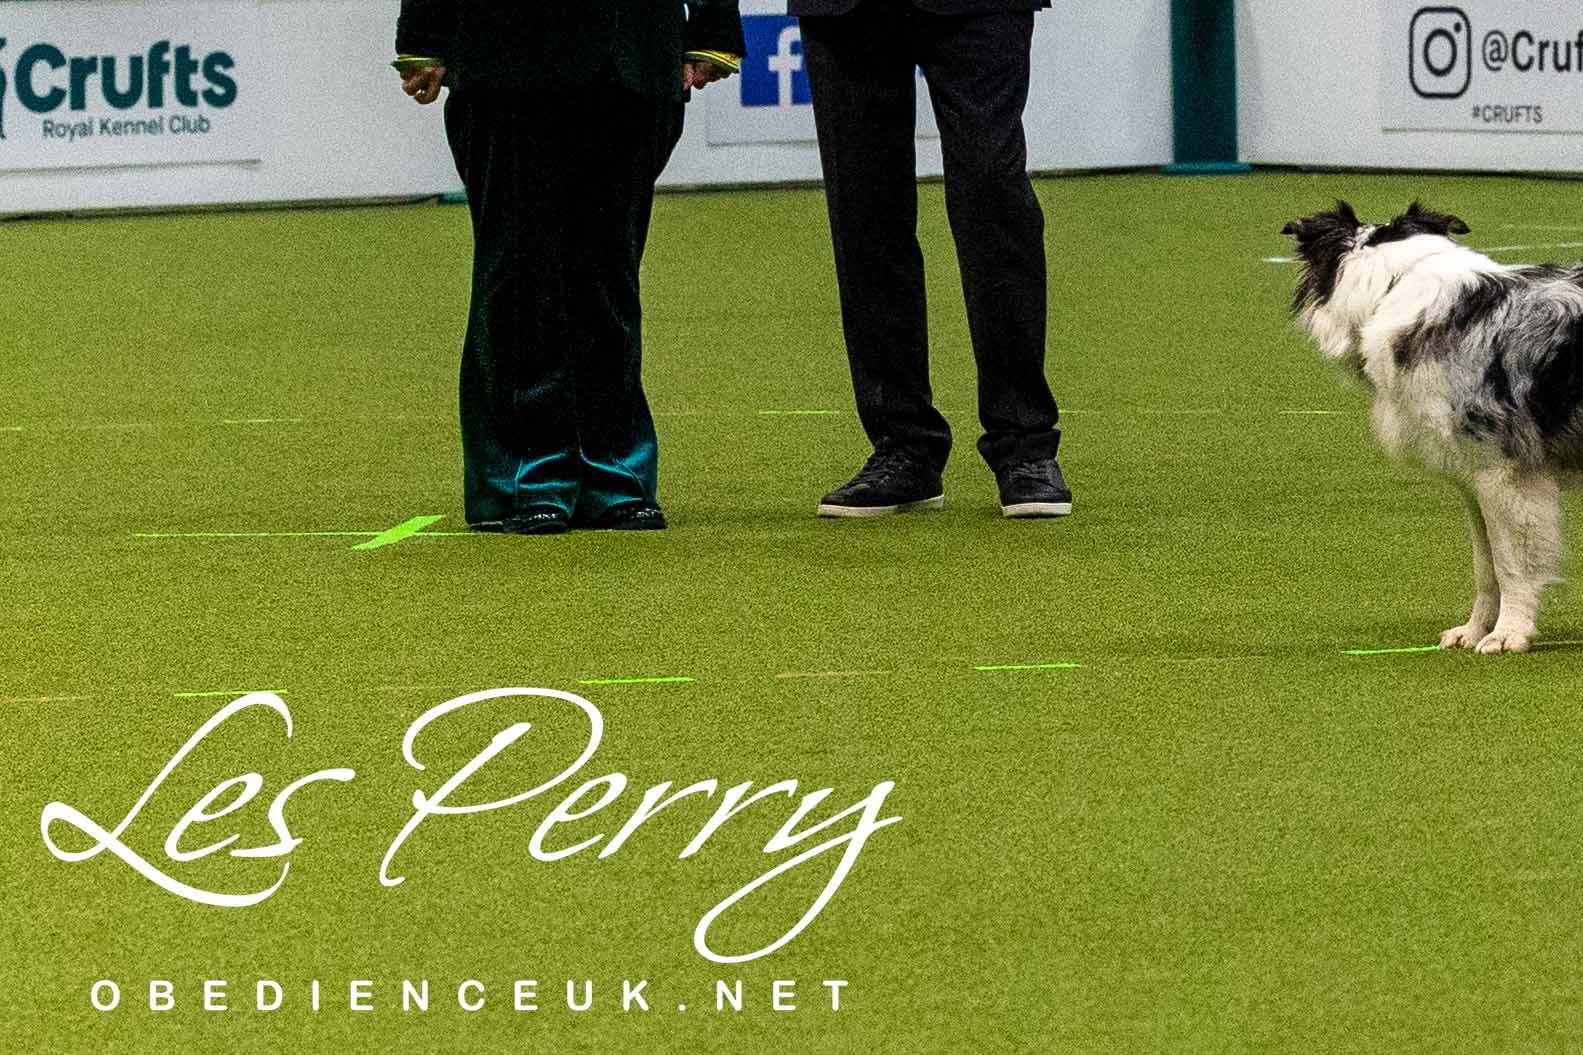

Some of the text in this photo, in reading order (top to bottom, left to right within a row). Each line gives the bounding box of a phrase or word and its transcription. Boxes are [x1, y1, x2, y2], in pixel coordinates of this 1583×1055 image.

[14, 39, 239, 114] Crufts
[42, 114, 211, 142] Royal Kennel Club
[1472, 104, 1544, 124] #CRUFTS
